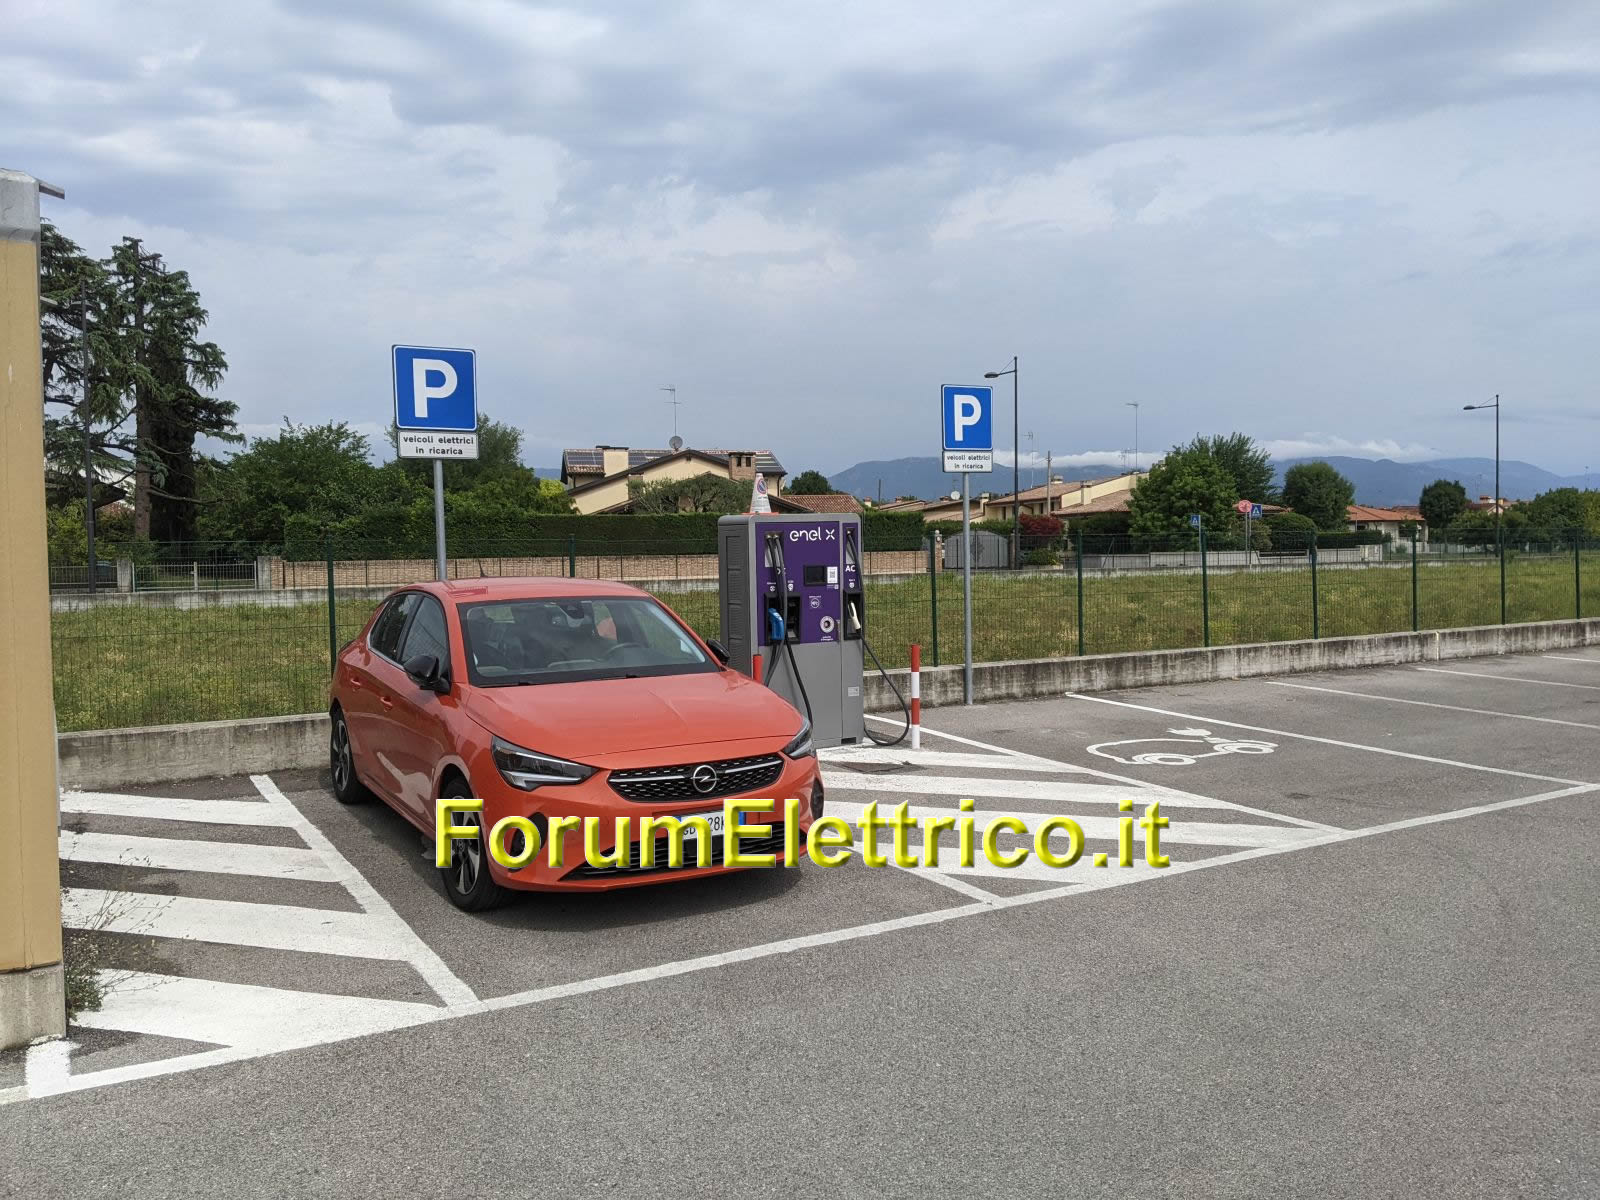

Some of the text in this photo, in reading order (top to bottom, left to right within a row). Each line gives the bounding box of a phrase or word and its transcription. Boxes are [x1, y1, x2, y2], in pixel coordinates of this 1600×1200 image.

[412, 358, 458, 418] P
[953, 394, 982, 442] P
[403, 435, 474, 445] veicoli elettrici
[415, 446, 463, 455] in ricarica
[789, 526, 822, 542] enel
[844, 564, 856, 573] AC
